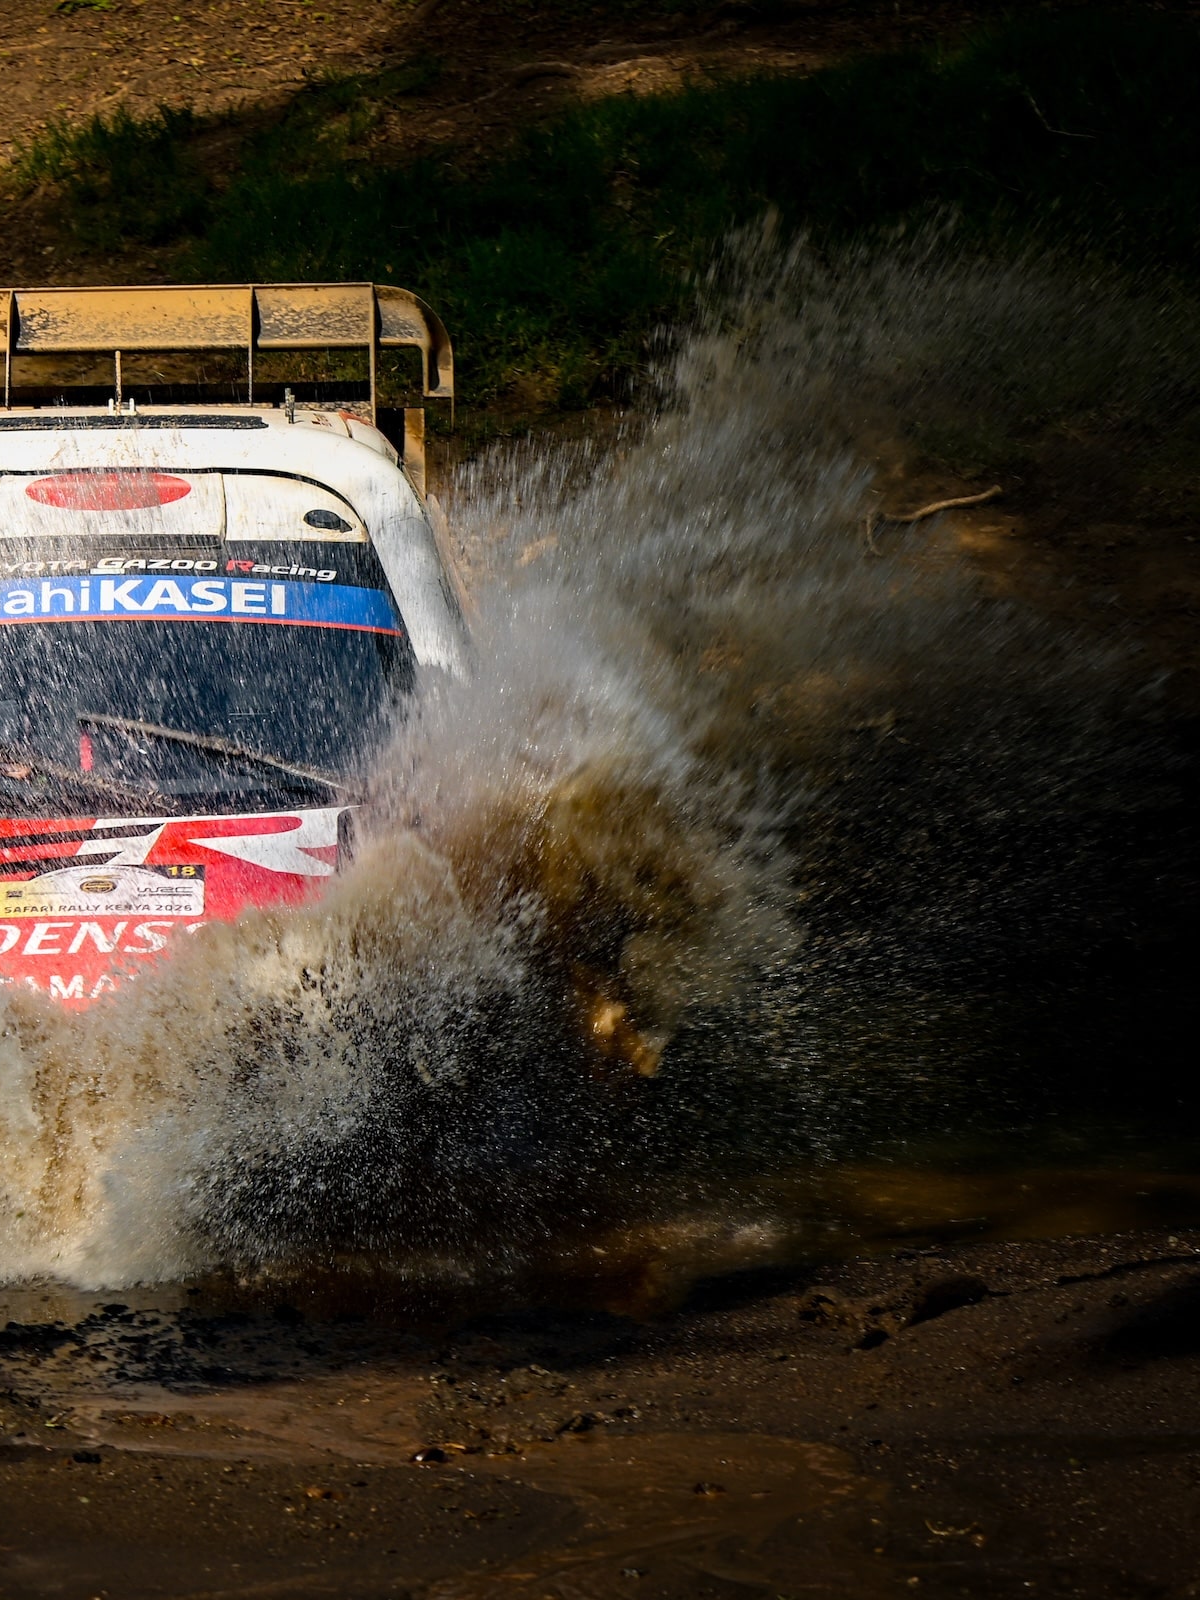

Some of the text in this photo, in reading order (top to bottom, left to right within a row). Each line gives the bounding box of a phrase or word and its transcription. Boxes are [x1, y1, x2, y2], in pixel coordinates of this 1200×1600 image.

[96, 557, 218, 573] GAZOO
[226, 560, 337, 581] Racing
[168, 866, 195, 876] 18
[4, 905, 53, 914] SAFARI
[58, 904, 100, 912] RALLY
[155, 904, 192, 912] 2026
